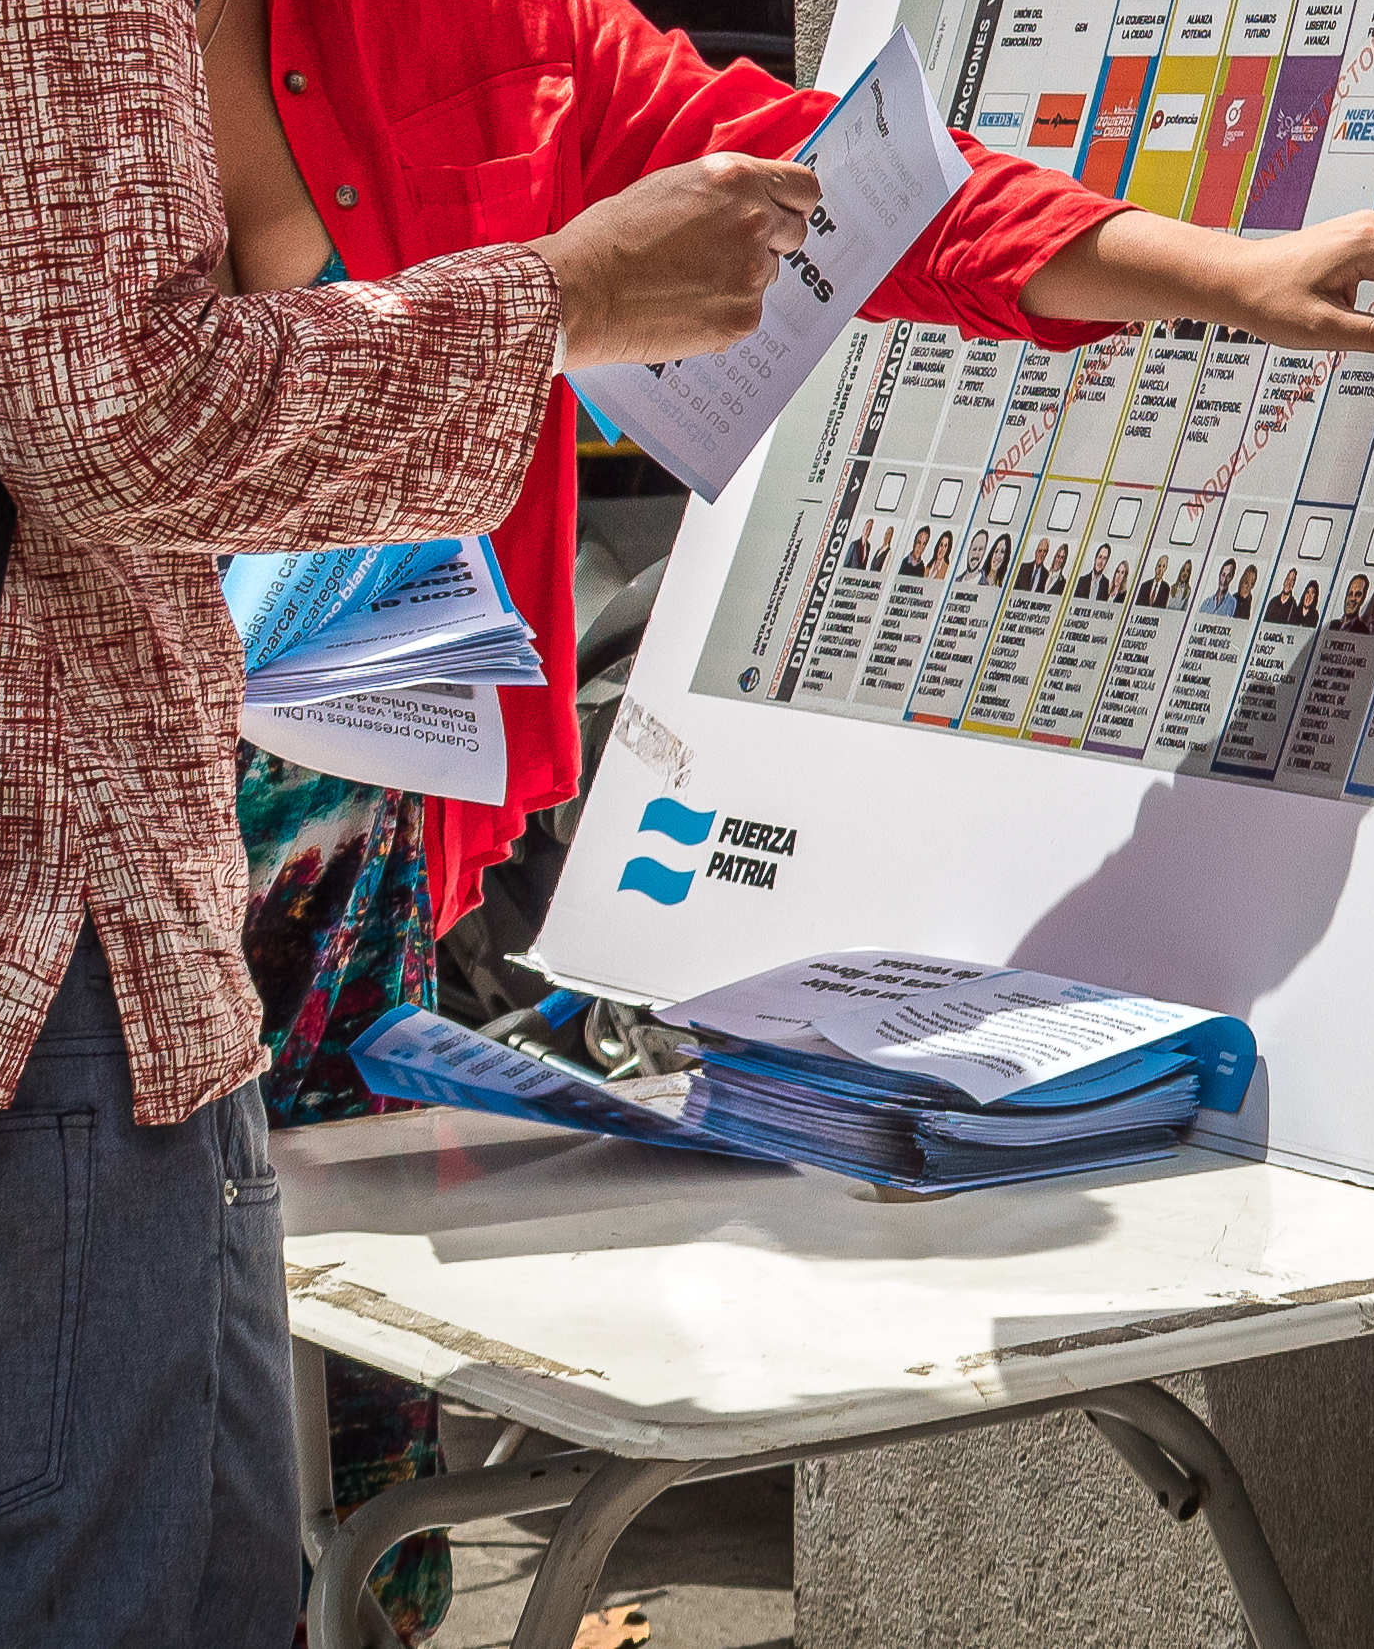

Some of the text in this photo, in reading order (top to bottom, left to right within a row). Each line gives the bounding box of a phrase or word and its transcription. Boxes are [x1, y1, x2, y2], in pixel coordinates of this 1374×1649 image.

[1304, 20, 1337, 32] LIBERTAD
[1303, 35, 1331, 47] AVANZA
[952, 18, 991, 130] PACIONES
[979, 112, 1011, 127] UCEDE
[1164, 114, 1199, 128] potencia
[832, 331, 860, 411] NACIONALES
[869, 322, 912, 431] SENADO
[789, 518, 850, 669] DIPUTADOS
[306, 708, 324, 723] tu
[327, 711, 411, 738] presentes
[421, 702, 476, 723] Boleta
[412, 727, 481, 753] Cuando
[717, 816, 798, 857] FUERZA
[705, 850, 778, 890] PATRIA
